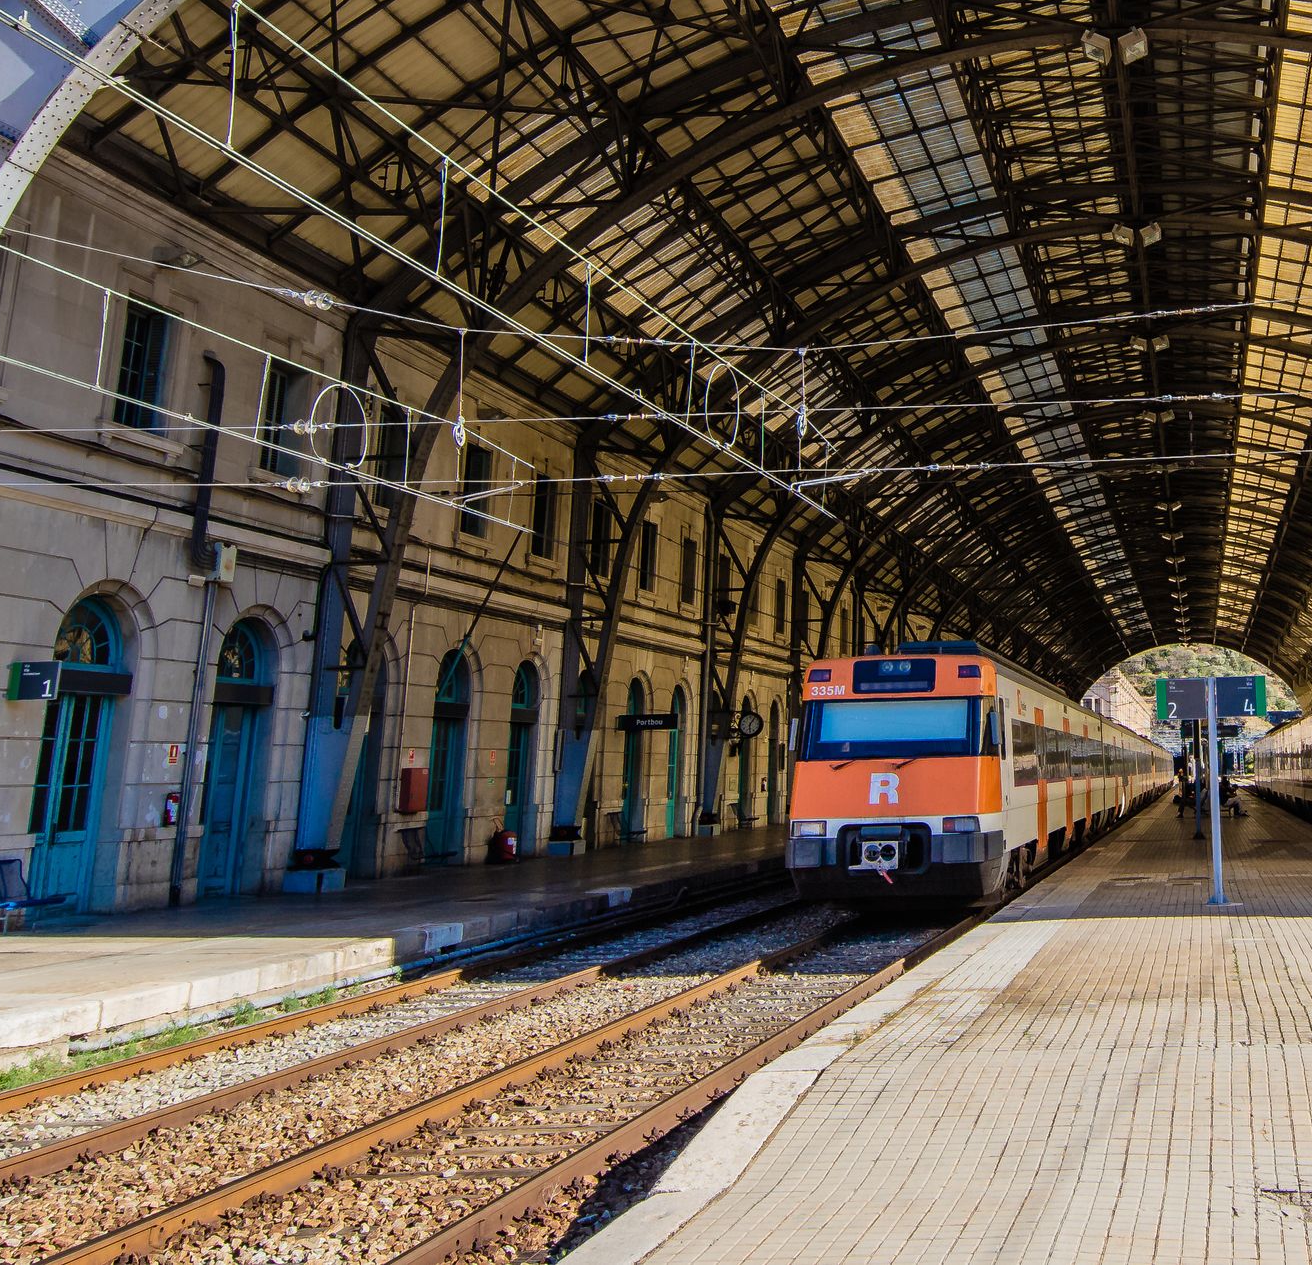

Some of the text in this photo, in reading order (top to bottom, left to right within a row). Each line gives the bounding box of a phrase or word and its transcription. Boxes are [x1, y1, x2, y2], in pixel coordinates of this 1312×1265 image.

[41, 679, 52, 698] 1
[810, 685, 846, 697] 335M
[1168, 702, 1178, 719] 2
[1243, 698, 1256, 716] 4
[868, 773, 900, 805] R
